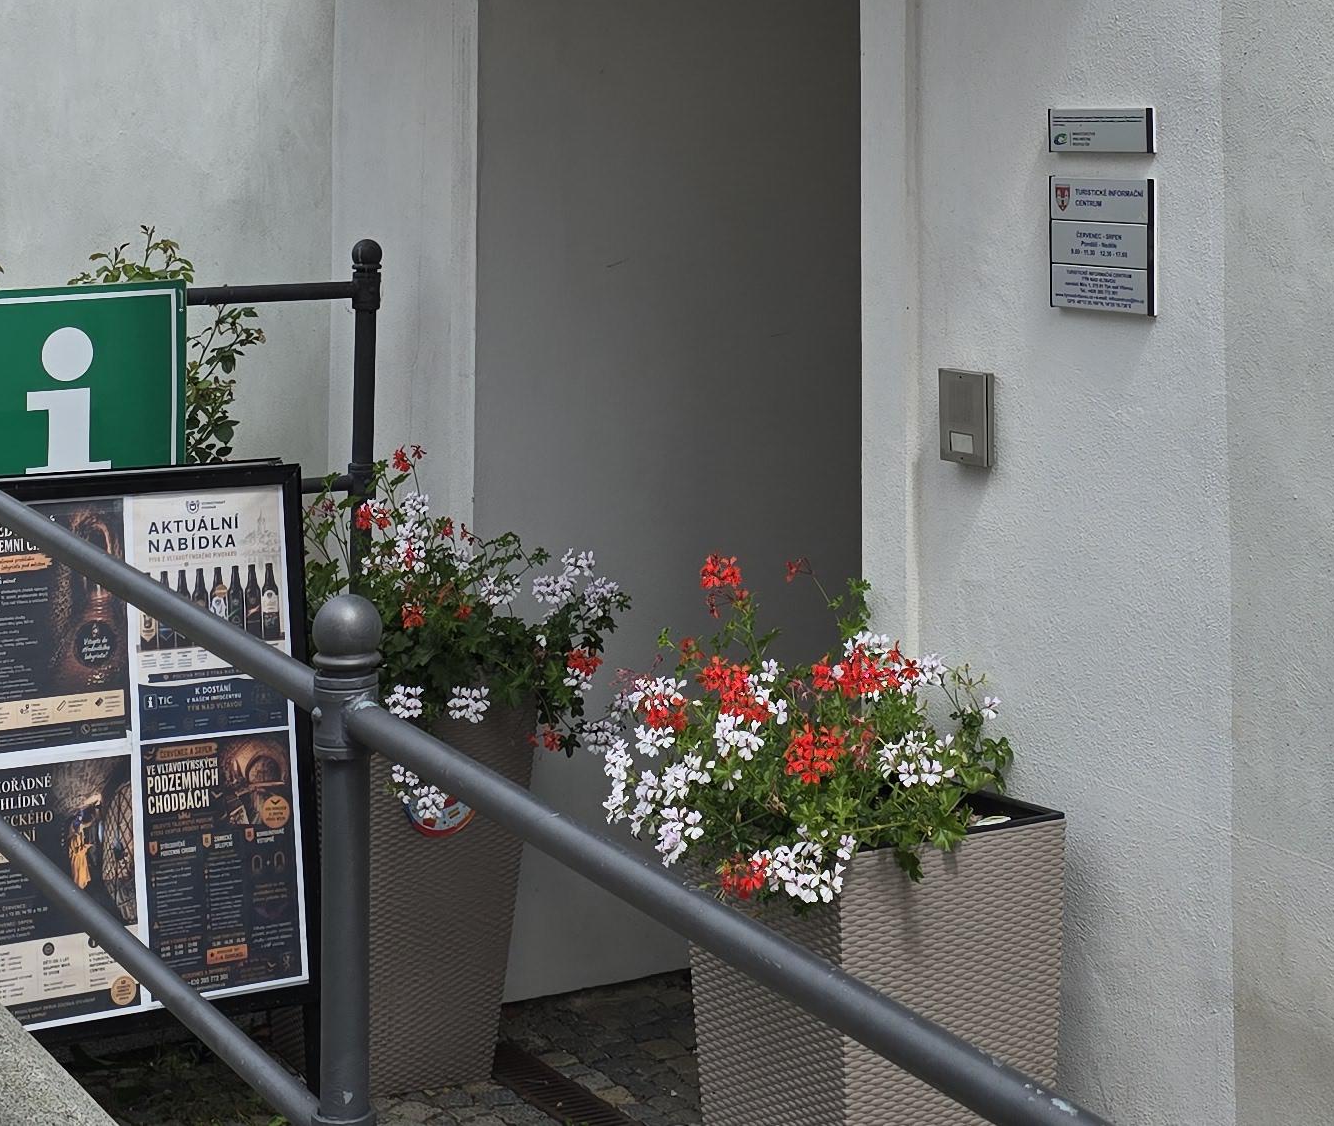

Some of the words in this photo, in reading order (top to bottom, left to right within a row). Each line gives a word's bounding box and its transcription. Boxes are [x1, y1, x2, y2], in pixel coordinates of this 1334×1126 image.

[1075, 199, 1102, 207] CENTRUM
[148, 513, 239, 535] AKTUÁLNÍ
[148, 532, 236, 553] NABÍDKA
[194, 687, 201, 695] K
[202, 683, 232, 694] DOSTÁNÍ
[158, 695, 173, 705] TIC
[189, 746, 194, 755] A
[146, 764, 156, 775] VE
[156, 757, 218, 773] VLTAVOTÝNSKÝCH
[147, 766, 219, 795] PODZEMNÍCH
[148, 786, 210, 815] CHODBÁCH
